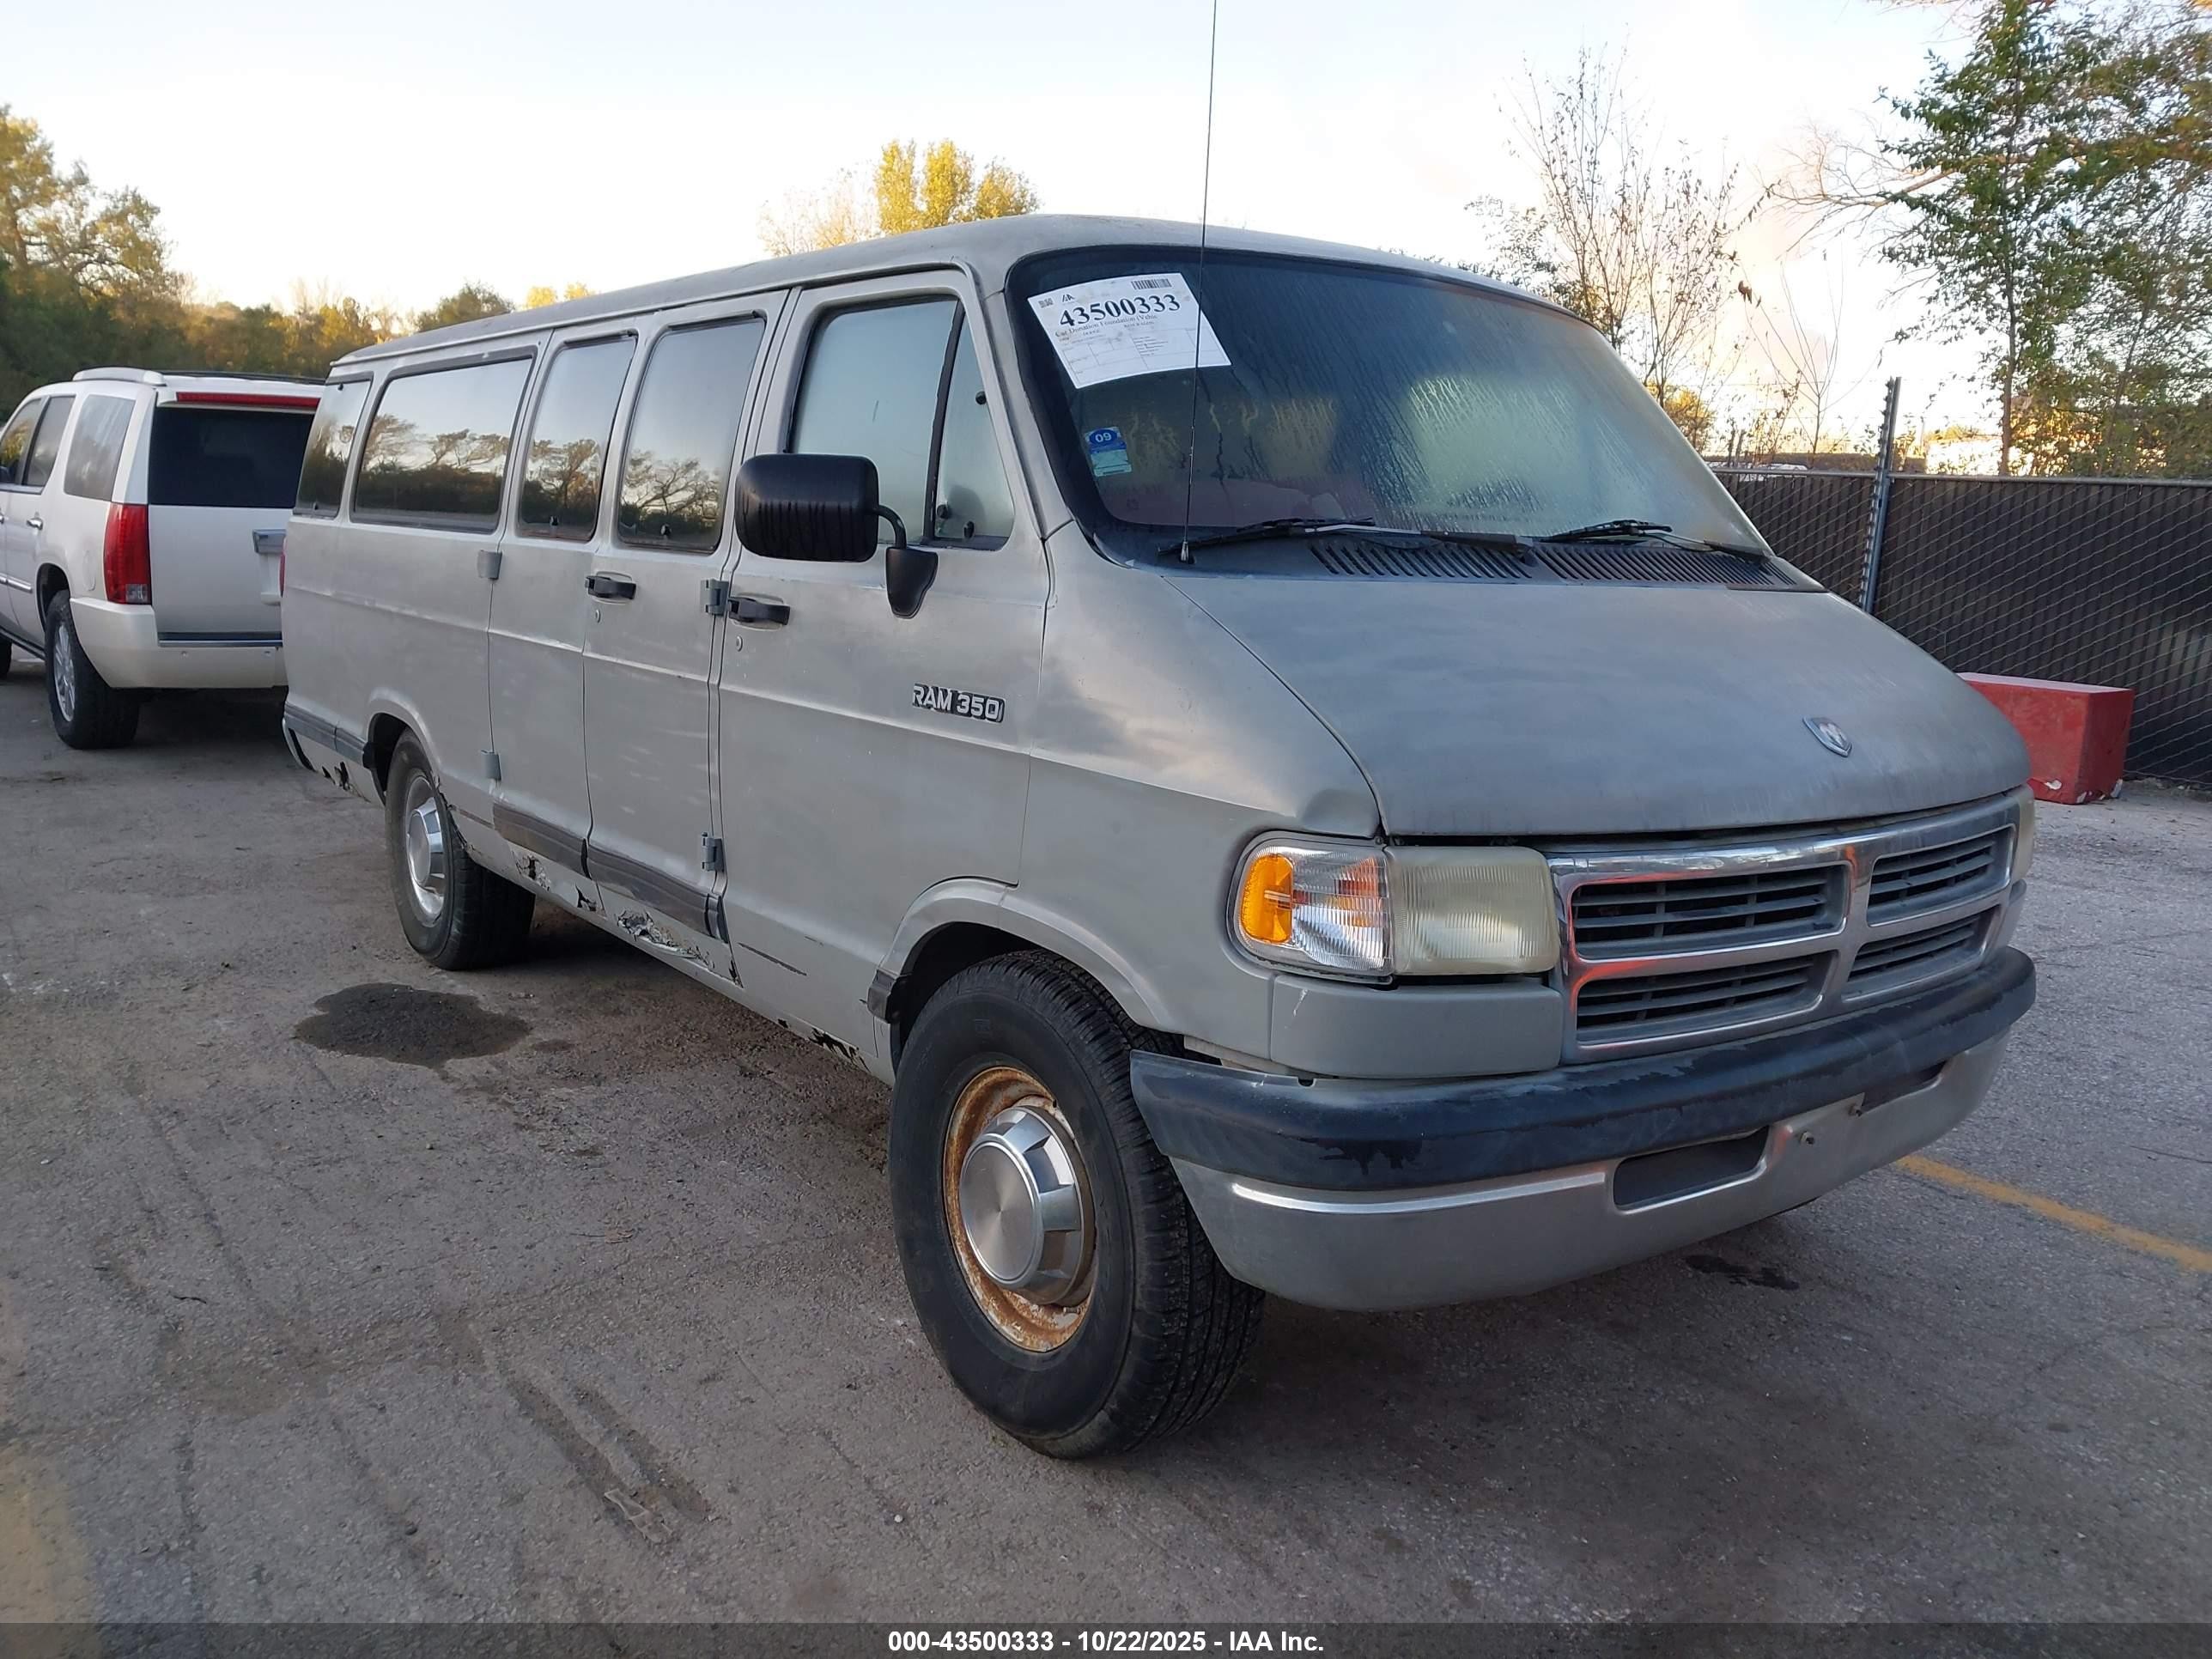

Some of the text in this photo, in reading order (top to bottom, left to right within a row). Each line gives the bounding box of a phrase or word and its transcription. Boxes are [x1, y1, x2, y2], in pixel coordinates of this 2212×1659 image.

[1060, 294, 1181, 327] 43500333
[1068, 321, 1099, 334] Donation
[1099, 316, 1136, 329] Foundation
[1095, 433, 1112, 442] 09
[913, 684, 1006, 722] RAM 350
